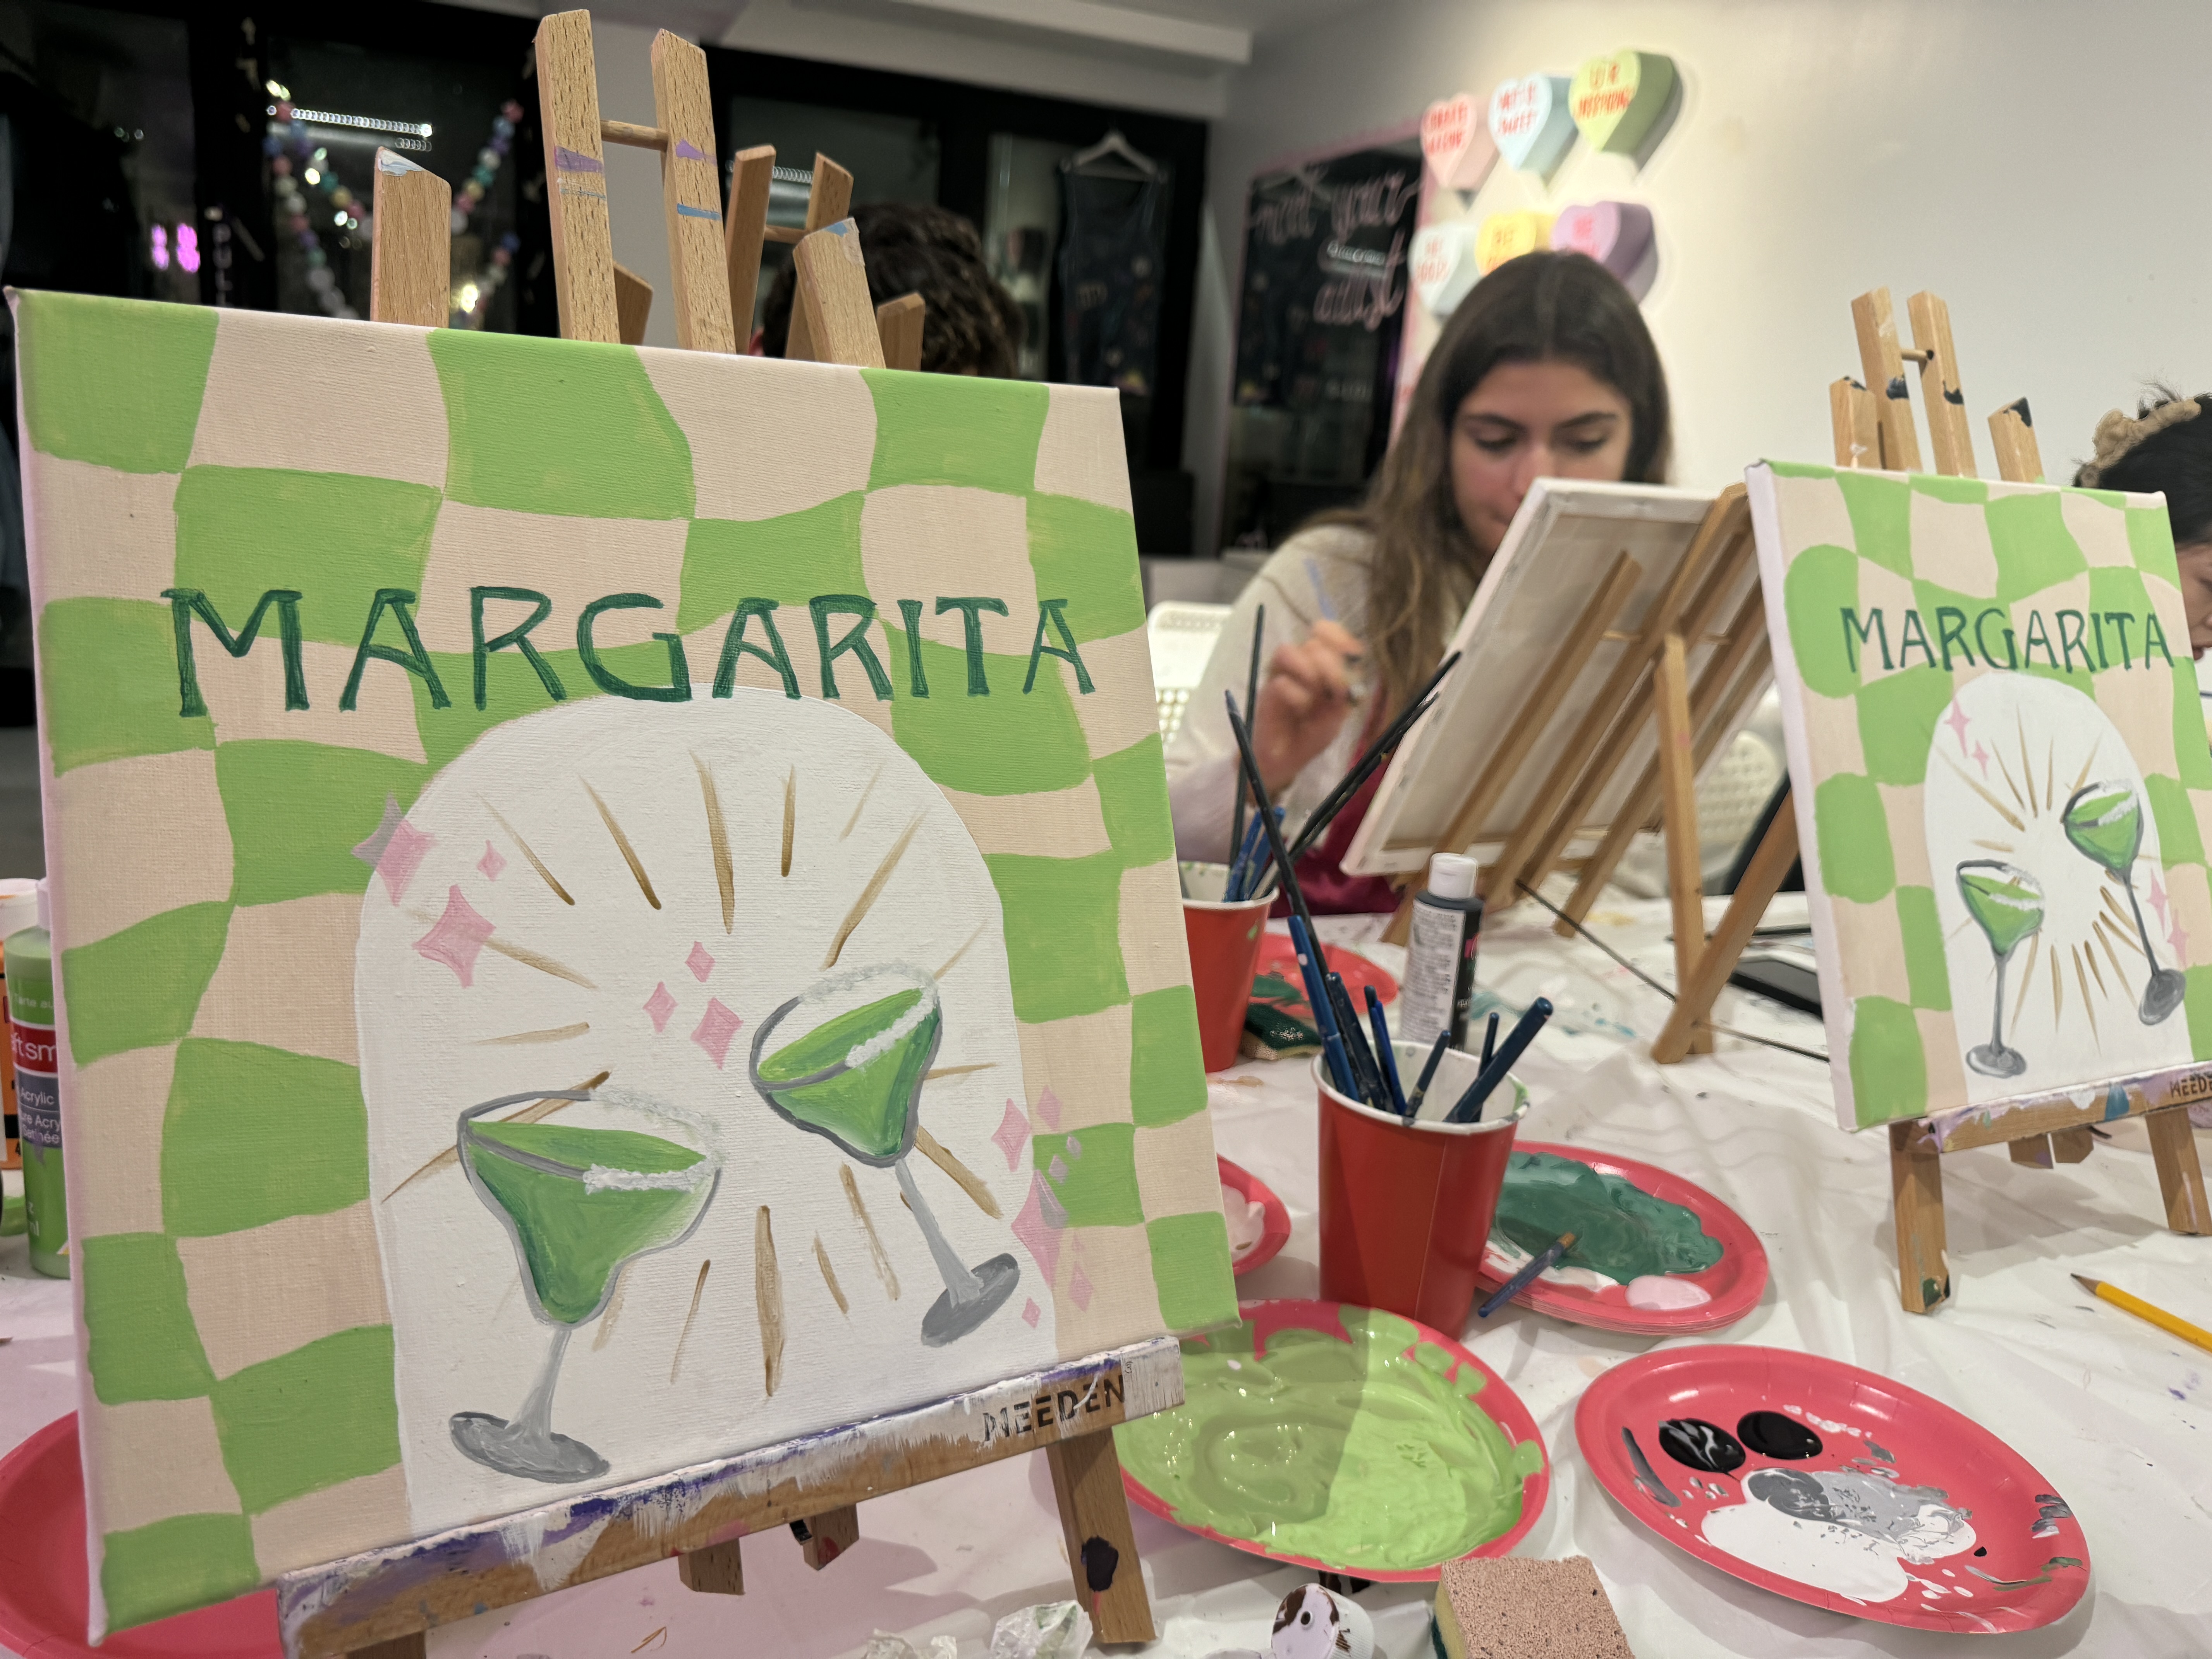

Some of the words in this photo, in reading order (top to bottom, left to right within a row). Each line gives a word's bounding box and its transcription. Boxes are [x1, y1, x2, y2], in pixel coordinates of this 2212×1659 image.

[161, 586, 1095, 717] MARGARITA
[1840, 606, 2175, 673] MARGARITA
[21, 1087, 55, 1107] Acrylic
[983, 1374, 1125, 1441] NEEDEN
